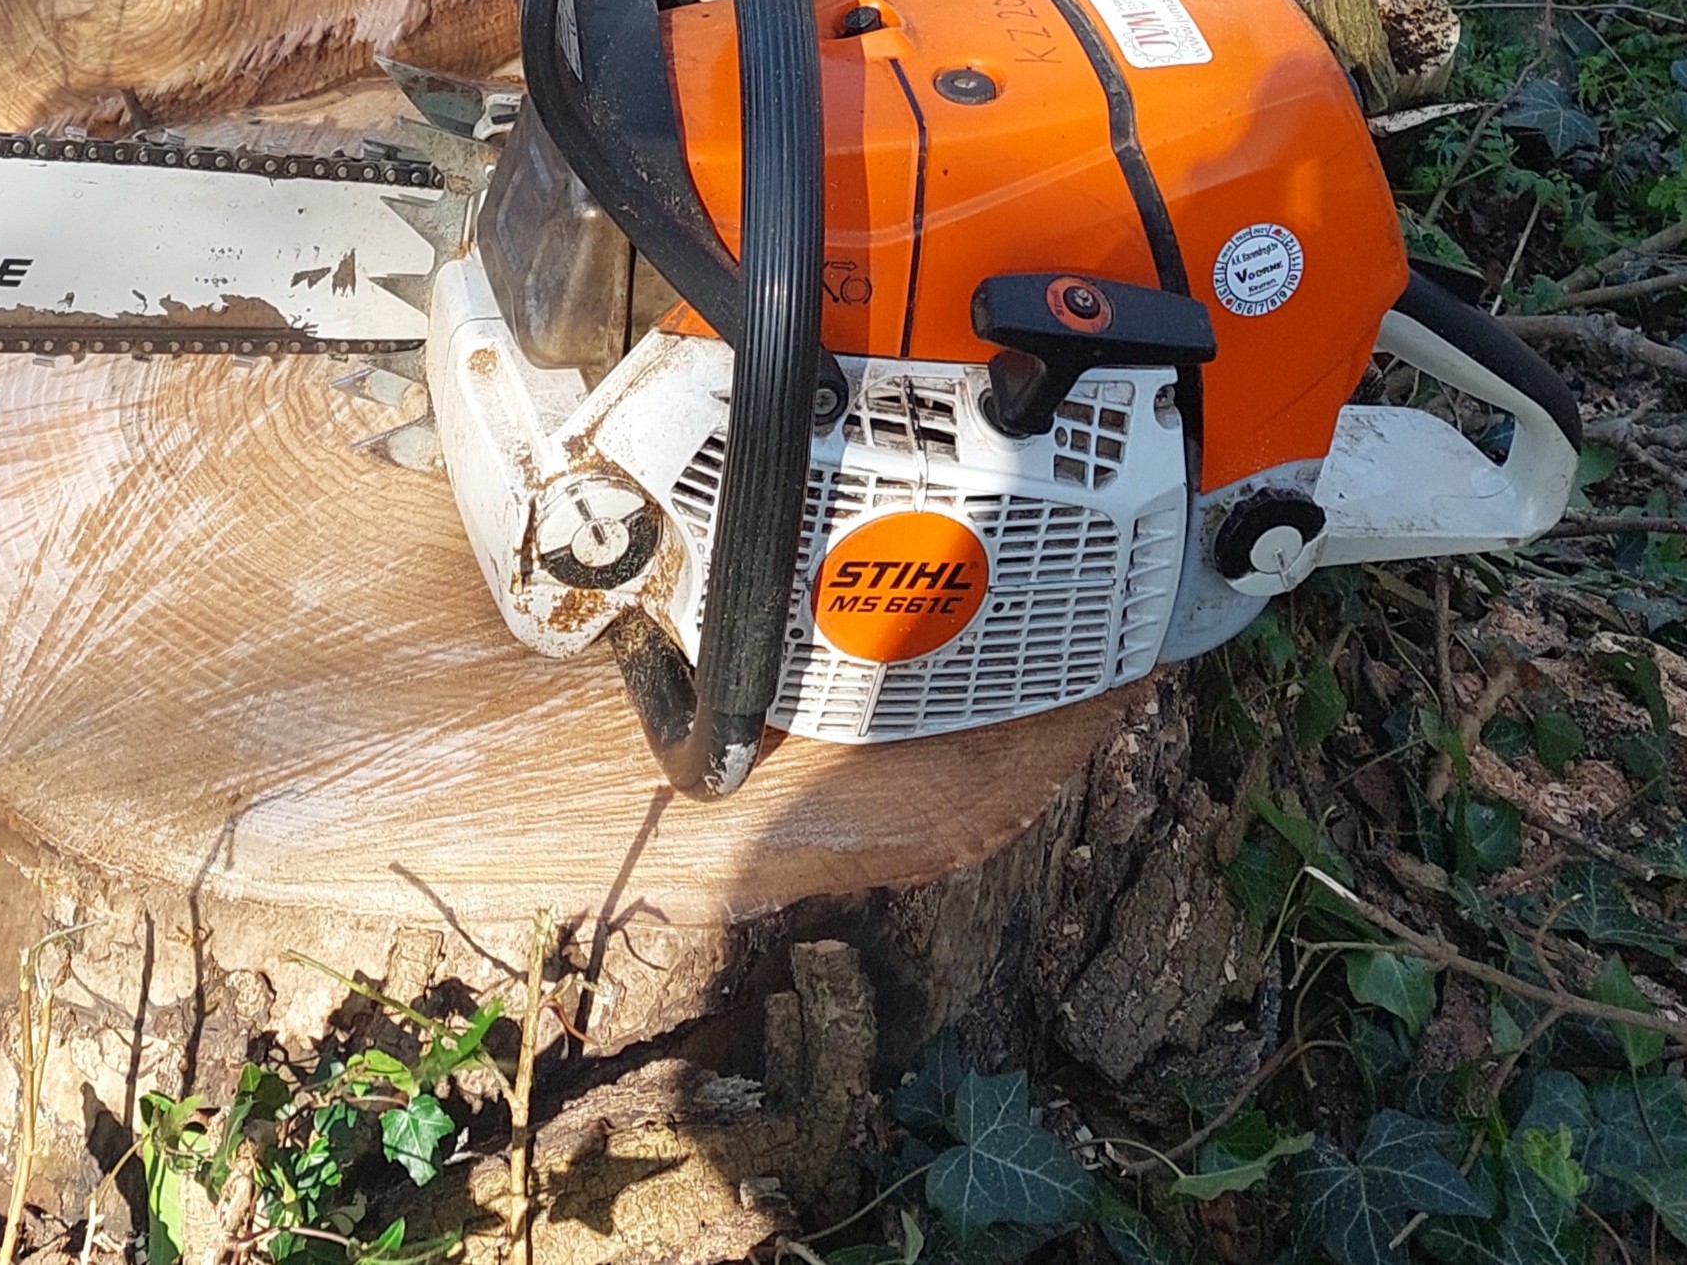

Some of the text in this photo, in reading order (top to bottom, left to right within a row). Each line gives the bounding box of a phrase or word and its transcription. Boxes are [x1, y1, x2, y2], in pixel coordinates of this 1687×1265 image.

[1121, 10, 1178, 48] JVM
[1285, 237, 1297, 251] 12
[1292, 256, 1301, 268] 11
[1287, 273, 1298, 286] 10
[1235, 303, 1243, 311] 5
[1247, 305, 1253, 314] 6
[1258, 303, 1265, 312] 7
[827, 561, 972, 590] STIHL
[827, 595, 964, 614] MS 661C
